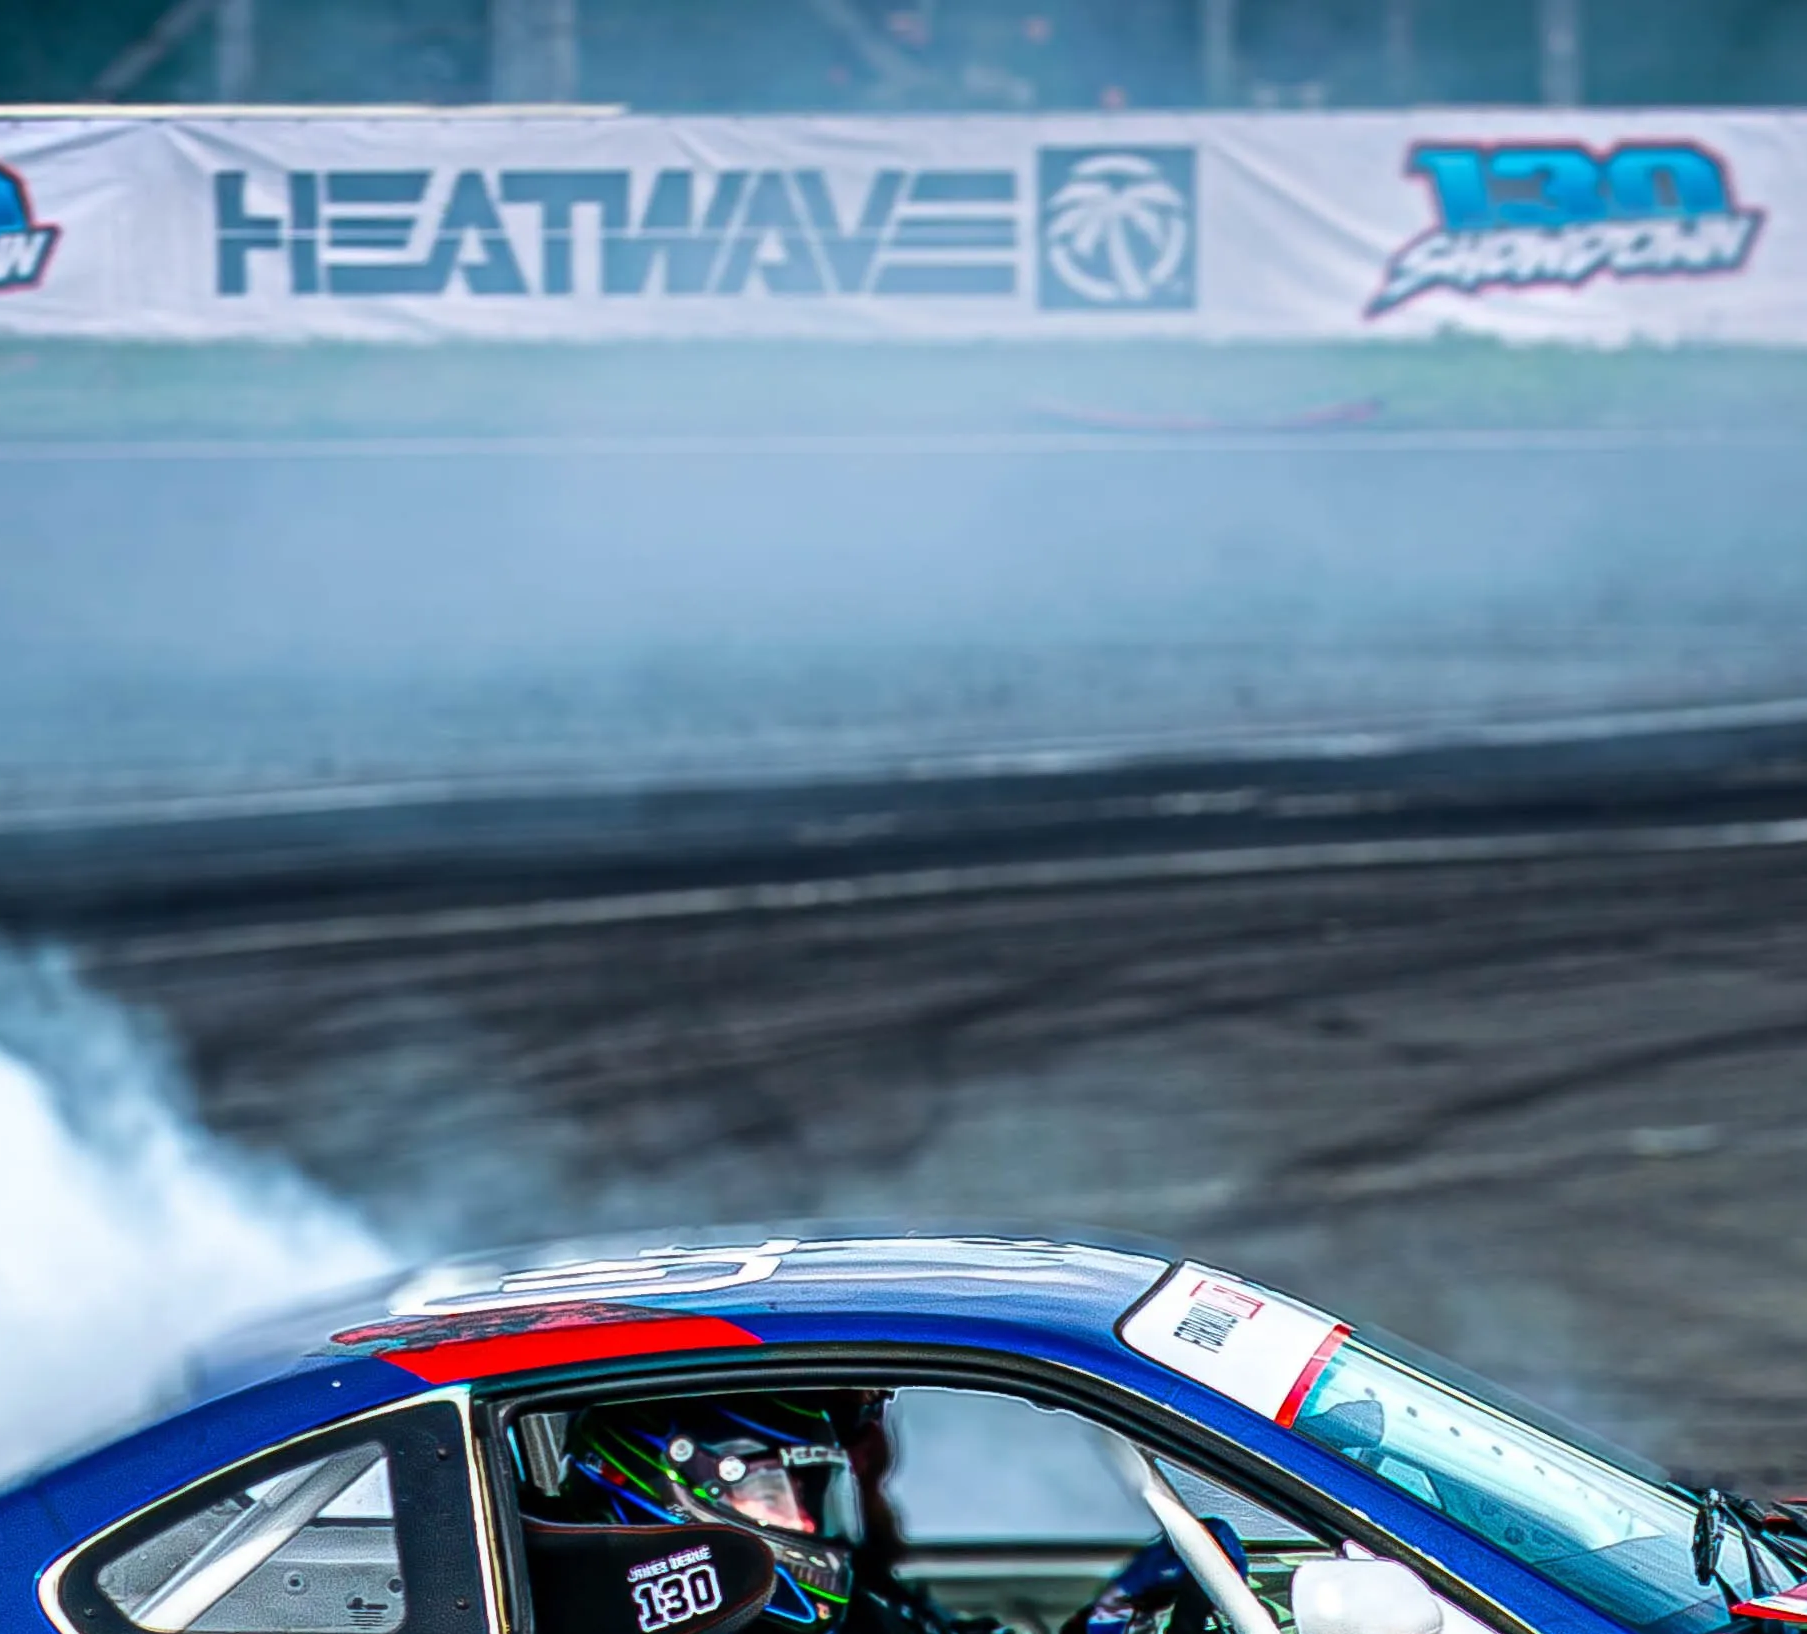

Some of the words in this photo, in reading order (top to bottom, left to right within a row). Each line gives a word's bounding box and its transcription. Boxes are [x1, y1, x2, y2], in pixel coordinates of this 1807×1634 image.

[1413, 146, 1731, 231] 130
[216, 168, 1018, 298] HEATWAVE
[633, 1564, 723, 1633] 130
